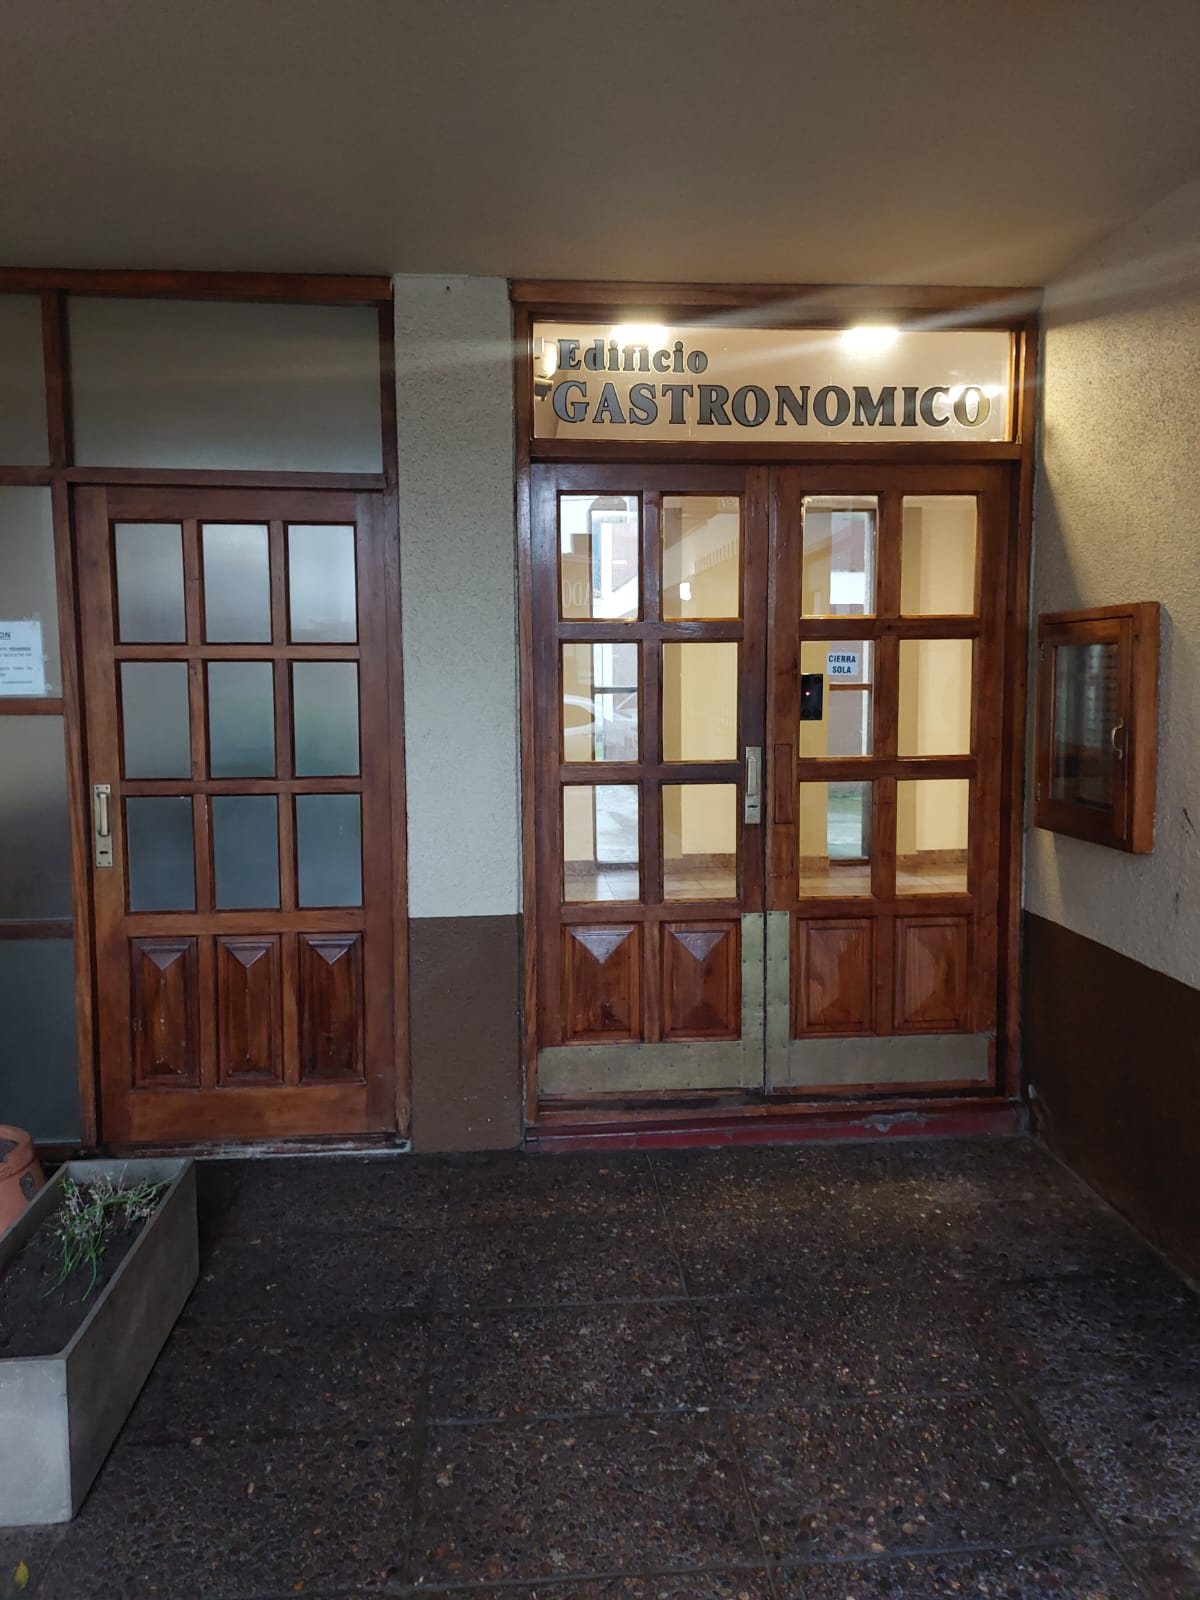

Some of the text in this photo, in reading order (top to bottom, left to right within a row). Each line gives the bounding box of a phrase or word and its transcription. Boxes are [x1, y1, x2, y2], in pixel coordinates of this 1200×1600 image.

[558, 339, 708, 374] Edificio
[553, 381, 990, 428] GASTRONOMICO
[828, 654, 857, 664] CIERRA
[832, 665, 852, 675] SOLA
